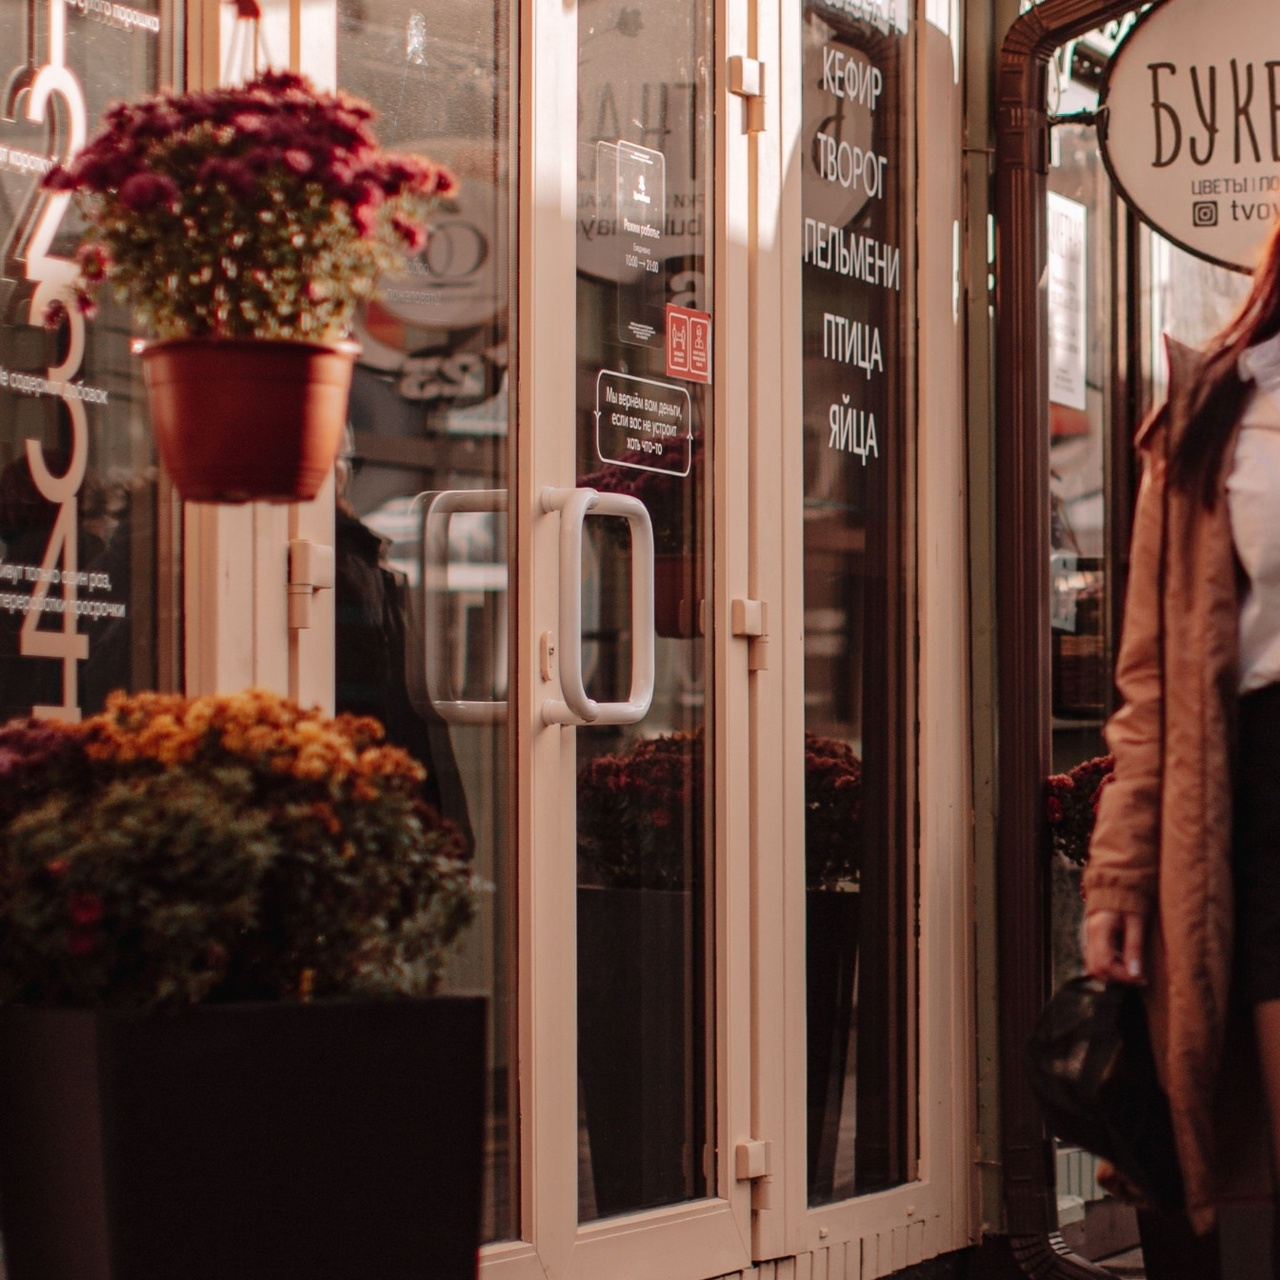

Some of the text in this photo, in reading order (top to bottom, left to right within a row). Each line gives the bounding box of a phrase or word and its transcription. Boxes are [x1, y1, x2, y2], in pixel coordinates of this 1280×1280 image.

[823, 45, 883, 110] КЕФИР
[816, 131, 888, 200] ТВОРОГ
[1191, 177, 1248, 195] ЦВЕТЫ
[804, 216, 900, 291] ПЕЛЬМЕНИ
[823, 311, 884, 381] ПТИЦА
[606, 386, 683, 421] Мы вернём вам деньги,
[611, 412, 678, 440] если вас не устроит
[828, 393, 879, 467] ЯЙЦА
[626, 437, 664, 457] хоть что-то
